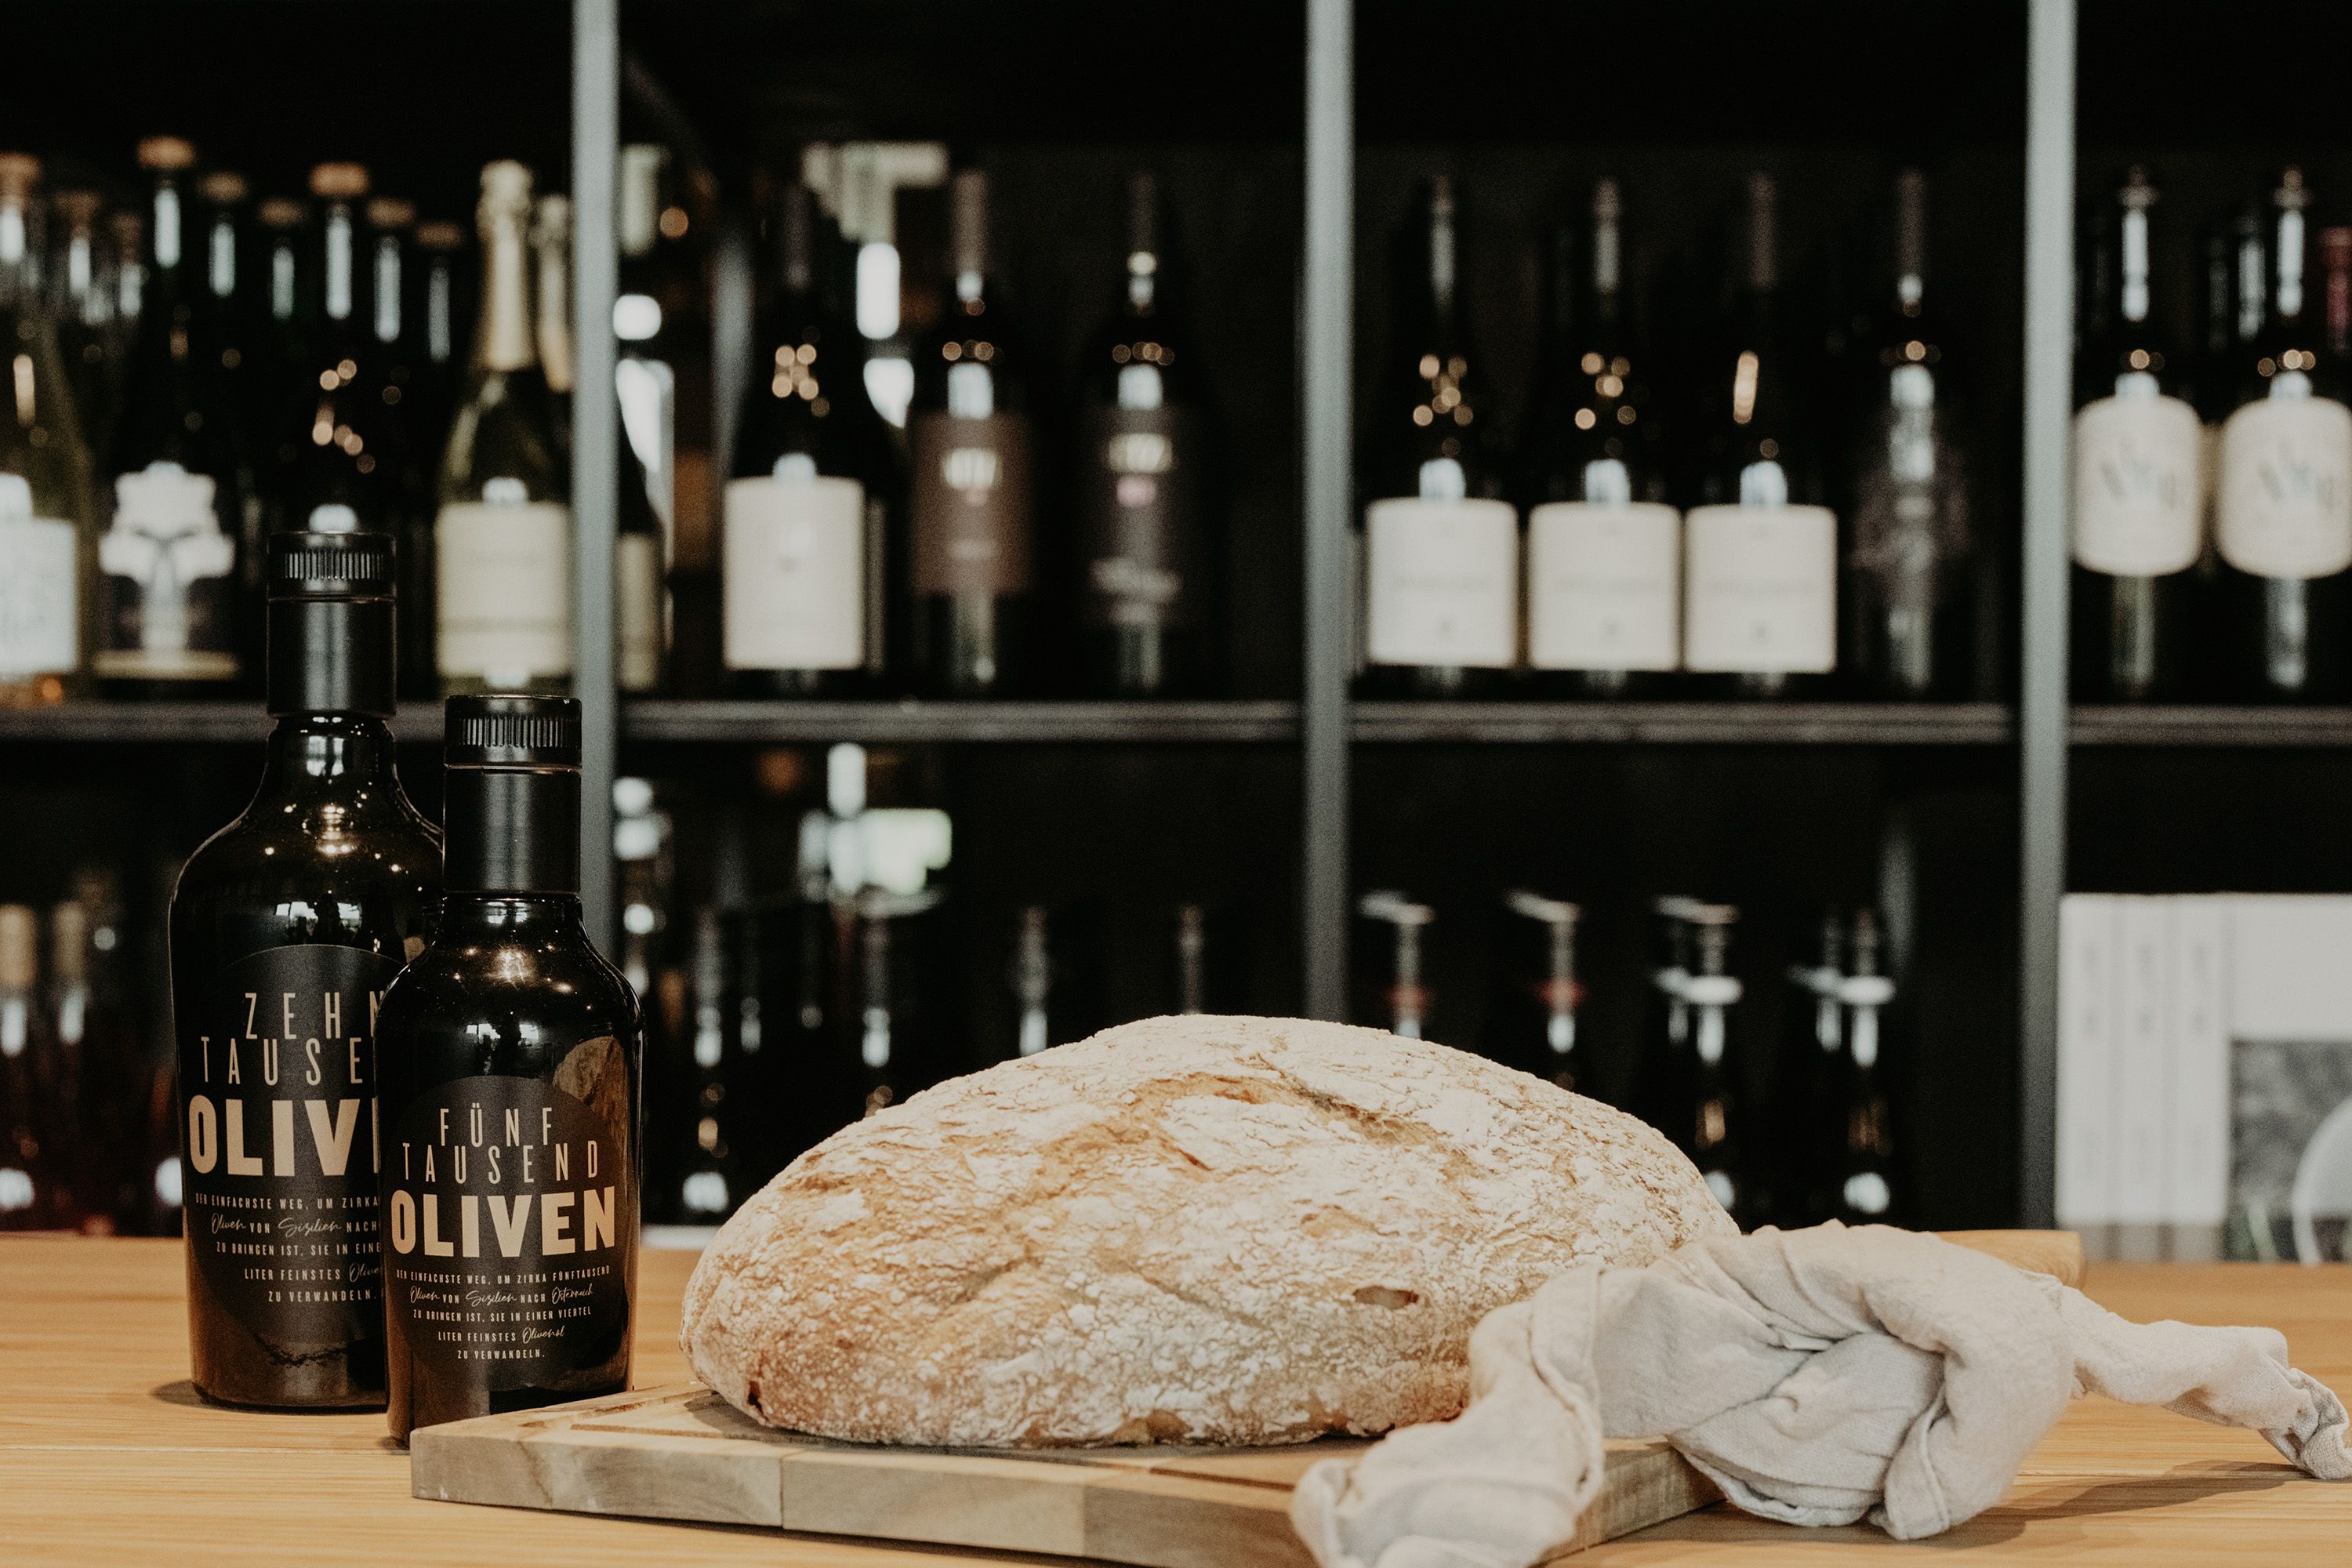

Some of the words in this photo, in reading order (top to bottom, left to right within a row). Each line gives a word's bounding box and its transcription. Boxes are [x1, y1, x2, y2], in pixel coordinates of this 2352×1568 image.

[245, 990, 385, 1040] ZEHN
[201, 1036, 363, 1086] TAUSE
[189, 1094, 379, 1176] OLIV
[440, 1102, 553, 1148] FÜNF
[402, 1140, 598, 1185] TAUSEND
[196, 1192, 207, 1205] DER
[212, 1196, 272, 1209] EINFACHSTE
[318, 1198, 333, 1209] UM
[342, 1196, 379, 1208] ZIRKA
[211, 1213, 246, 1234] Oliven
[249, 1222, 270, 1234] VON
[278, 1217, 341, 1237] Sizilien
[346, 1221, 377, 1233] NACH
[390, 1185, 615, 1258] OLIVEN
[216, 1241, 226, 1253] ZU
[232, 1243, 274, 1255] BRINGEN
[310, 1244, 328, 1255] SIE
[336, 1243, 348, 1254] IN
[355, 1242, 381, 1254] EINE
[245, 1268, 273, 1280] LITER
[281, 1269, 340, 1281] FEINSTES
[349, 1262, 380, 1282] Olive
[397, 1269, 407, 1279] DER
[411, 1272, 461, 1284] EINFACHSTE
[497, 1275, 510, 1284] UM
[517, 1273, 546, 1283] ZIRKA
[268, 1290, 281, 1302] ZU
[289, 1290, 376, 1302] VERWANDELN.
[410, 1286, 440, 1304] Oliven
[443, 1294, 459, 1304] VON
[466, 1290, 517, 1307] Sizilien
[521, 1293, 546, 1304] NACH
[413, 1309, 422, 1319] ZU
[426, 1310, 461, 1322] BRINGEN
[490, 1312, 505, 1322] SIE
[510, 1312, 521, 1322] IN
[526, 1310, 553, 1321] EINEN
[558, 1306, 591, 1319] VIERTEL
[438, 1331, 462, 1341] LITER
[467, 1331, 516, 1342] FEINSTES
[457, 1350, 468, 1359] ZU
[474, 1348, 545, 1359] VERWANDELN.
